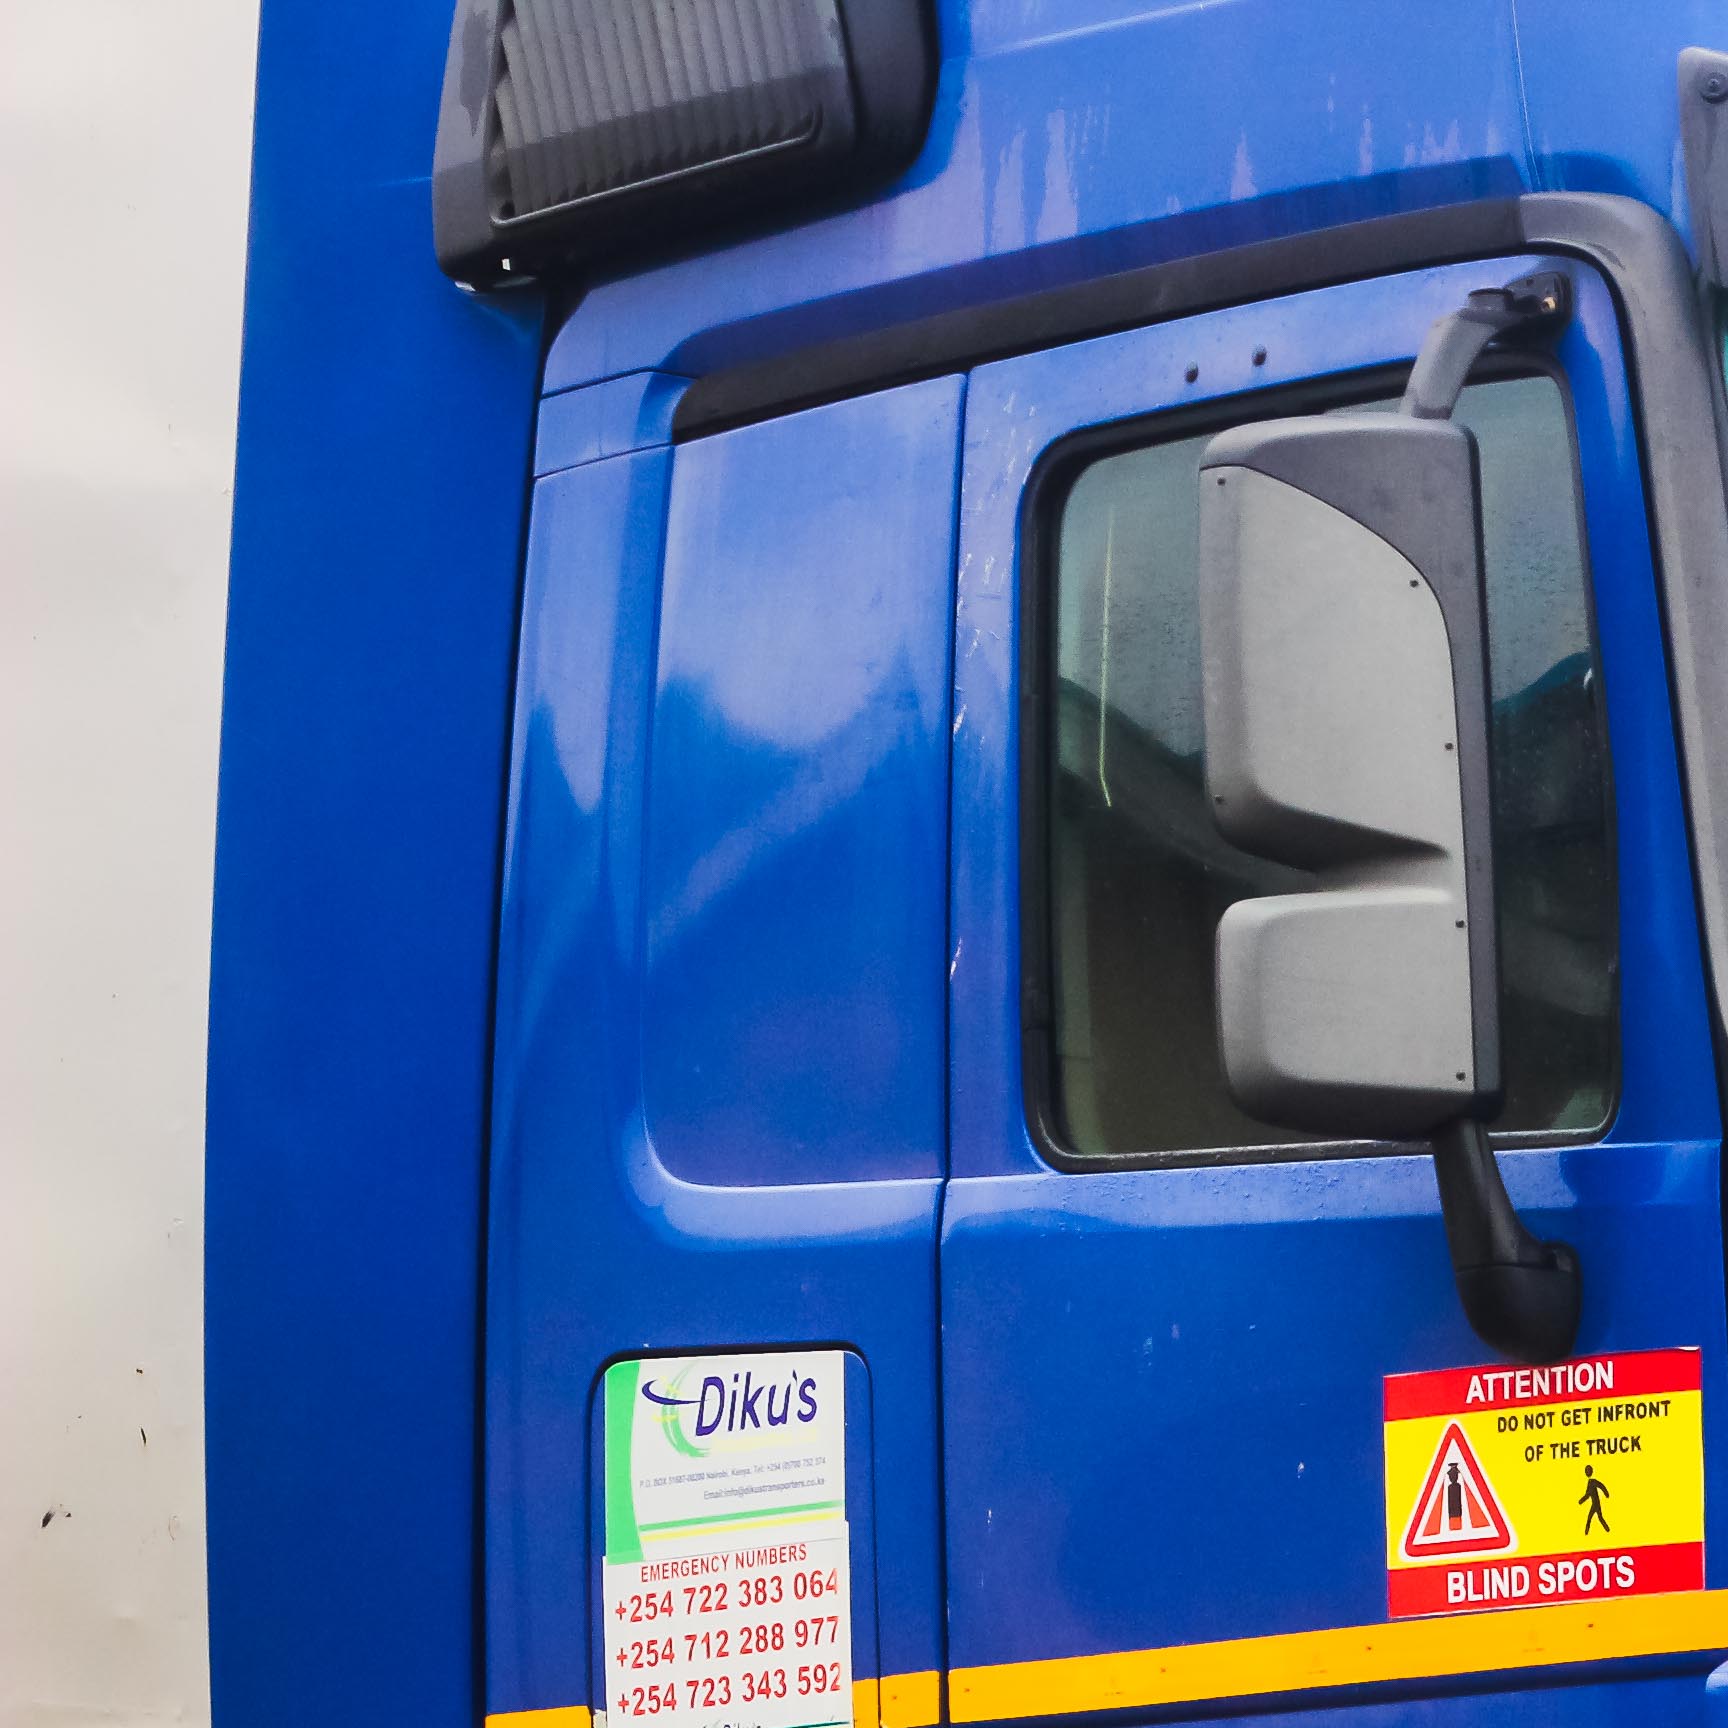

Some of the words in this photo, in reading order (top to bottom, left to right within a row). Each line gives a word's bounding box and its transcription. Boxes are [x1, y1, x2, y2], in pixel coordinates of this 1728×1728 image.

[695, 1369, 818, 1437] Diku's
[1466, 1361, 1614, 1403] ATTENTION
[1497, 1416, 1518, 1433] DO
[1524, 1411, 1555, 1430] NOT
[1561, 1407, 1592, 1427] GET
[1597, 1400, 1671, 1423] INFRONT
[1525, 1445, 1544, 1462] OF
[1550, 1440, 1580, 1458] THE
[1586, 1435, 1641, 1457] TRUCK
[641, 1554, 730, 1583] EMERGENCY
[735, 1543, 807, 1569] NUMBERS
[1447, 1564, 1530, 1603] BLIND
[1538, 1555, 1635, 1595] SPOTS
[615, 1590, 673, 1622] +254
[683, 1582, 728, 1614] 722
[738, 1575, 783, 1607] 383
[793, 1568, 838, 1600] 064
[616, 1637, 675, 1669] +254
[684, 1629, 729, 1661] 712
[739, 1622, 784, 1655] 288
[794, 1616, 839, 1647] 977
[617, 1682, 677, 1715] +254
[686, 1675, 731, 1708] 723
[741, 1668, 787, 1702] 343
[798, 1662, 841, 1696] 592
